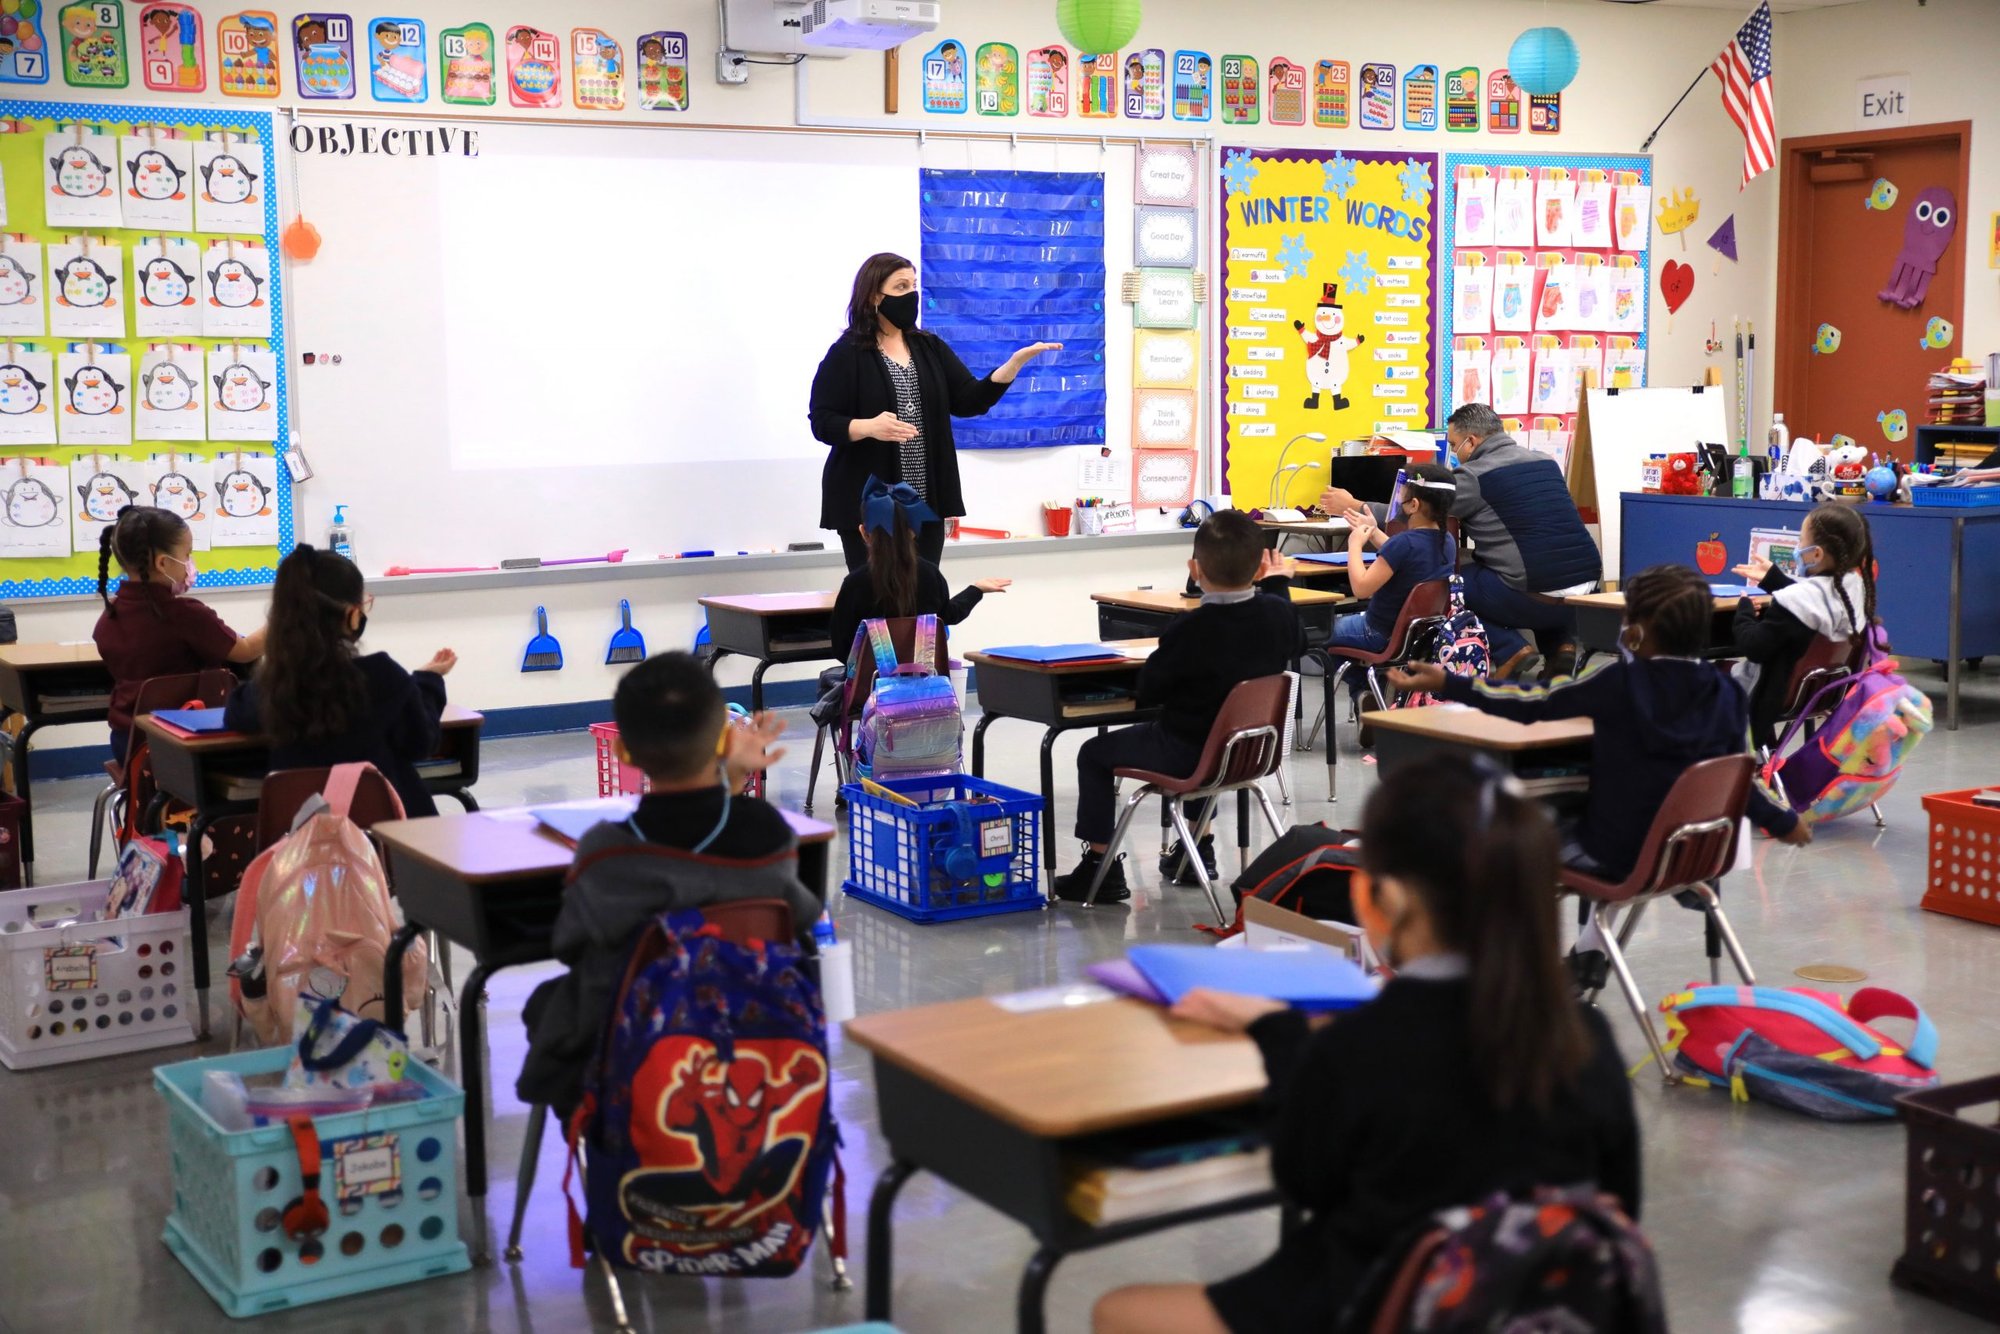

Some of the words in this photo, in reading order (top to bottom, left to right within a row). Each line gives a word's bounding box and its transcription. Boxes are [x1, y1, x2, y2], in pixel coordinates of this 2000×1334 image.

[100, 7, 112, 22] 8
[331, 21, 344, 38] 11
[401, 28, 416, 43] 12
[228, 34, 245, 50] 10
[449, 39, 464, 54] 13
[580, 37, 595, 51] 15
[666, 40, 680, 54] 16
[536, 43, 552, 58] 14
[24, 57, 35, 74] 7
[1097, 55, 1112, 67] 20
[1179, 58, 1193, 71] 22
[156, 66, 167, 81] 9
[931, 64, 943, 76] 17
[1225, 62, 1239, 76] 23
[1332, 68, 1346, 80] 25
[1288, 73, 1301, 86] 24
[1378, 70, 1392, 83] 26
[1450, 79, 1462, 91] 28
[1492, 81, 1504, 94] 29
[983, 94, 995, 108] 18
[1052, 96, 1064, 109] 19
[1129, 98, 1142, 111] 21
[1863, 91, 1904, 117] Exit
[1421, 111, 1434, 123] 27
[1533, 110, 1545, 122] 30
[289, 123, 479, 157] OBJECTIVE
[1150, 170, 1170, 179] Great
[1171, 172, 1185, 181] Day
[1240, 196, 1330, 227] WINTER
[1346, 199, 1426, 242] WORDS
[1150, 232, 1169, 241] Good
[1170, 233, 1184, 243] Day
[1241, 251, 1266, 259] earmuffs
[1152, 288, 1175, 298] Ready
[1240, 291, 1266, 299] snowflake
[1159, 297, 1179, 305] Learn
[1401, 297, 1416, 305] gloves
[1150, 355, 1184, 363] Reminder
[1243, 368, 1263, 377] sledding
[1398, 369, 1414, 377] jacket
[1256, 389, 1275, 397] skating
[1157, 410, 1175, 418] Think
[1152, 419, 1174, 427] About
[1141, 473, 1187, 484] Consequence
[638, 1221, 793, 1273] SPIDER-MAN
